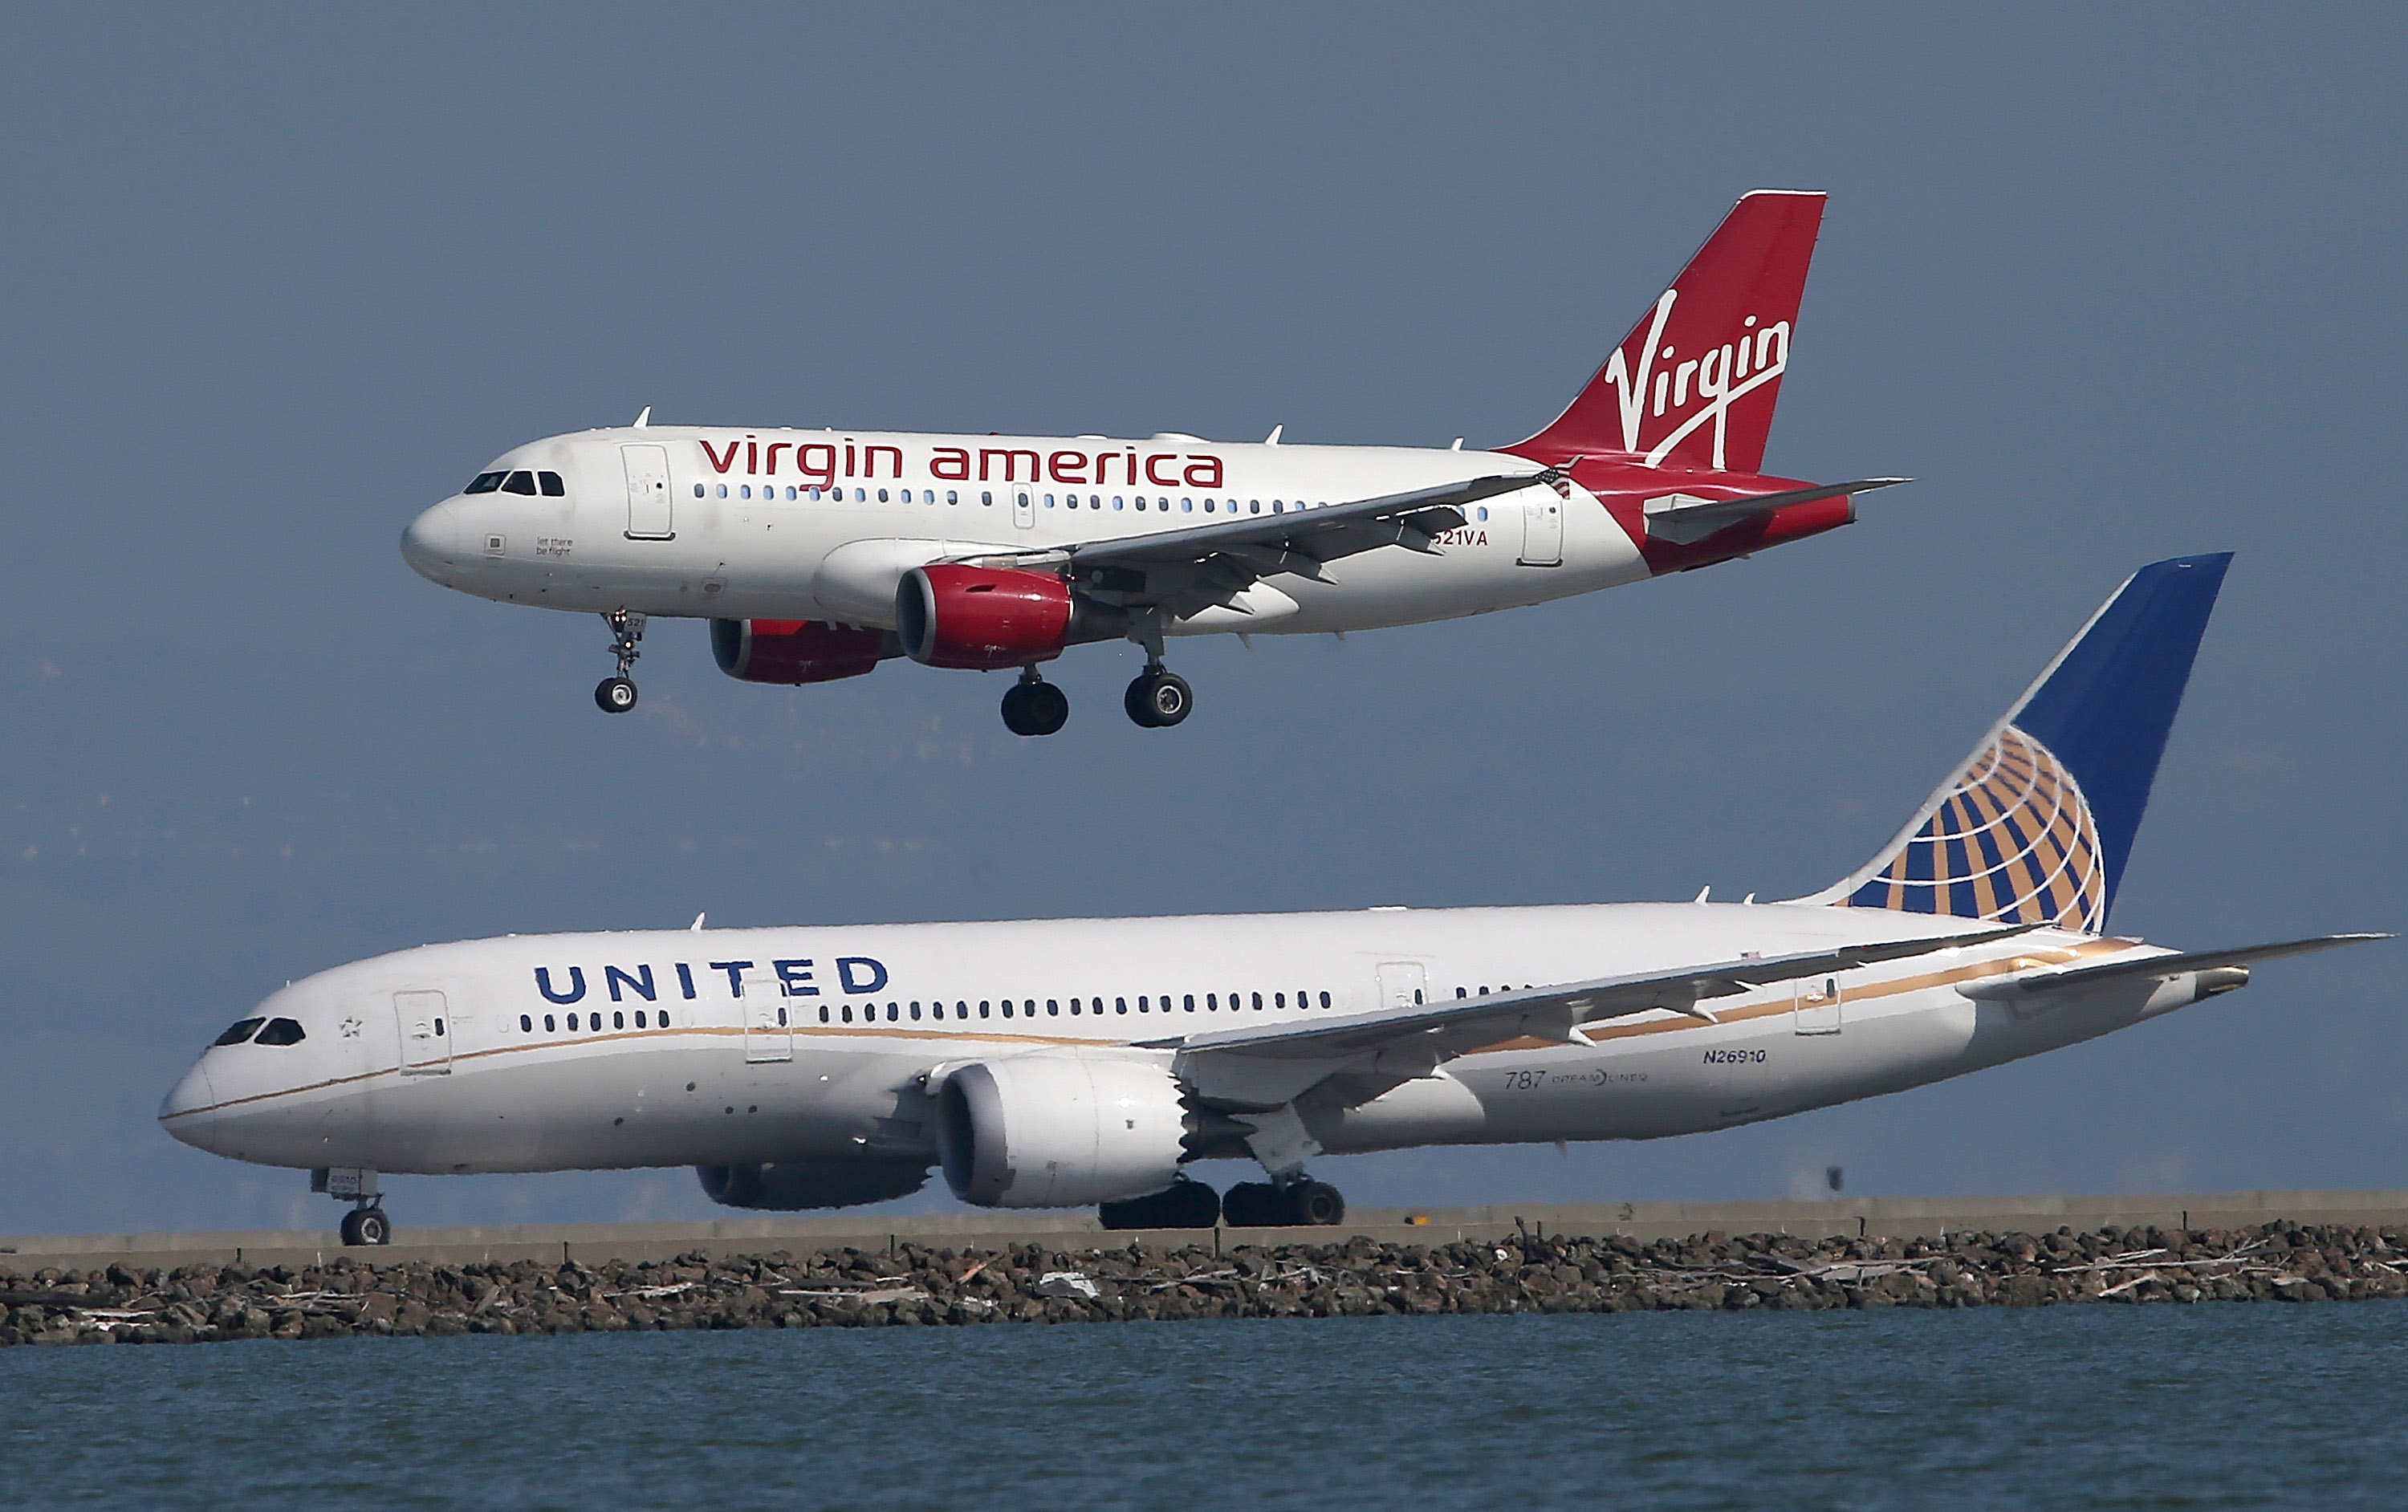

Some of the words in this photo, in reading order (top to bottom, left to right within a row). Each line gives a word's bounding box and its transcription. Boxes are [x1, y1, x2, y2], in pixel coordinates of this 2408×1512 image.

[1605, 289, 1790, 470] Virgin
[699, 434, 902, 492] virgin
[929, 445, 1223, 488] america
[537, 536, 548, 545] let
[551, 538, 573, 547] there
[536, 546, 547, 555] be
[628, 618, 644, 626] 521
[535, 957, 889, 1005] UNITED
[1703, 1050, 1766, 1064] N26910
[1505, 1070, 1547, 1090] 787
